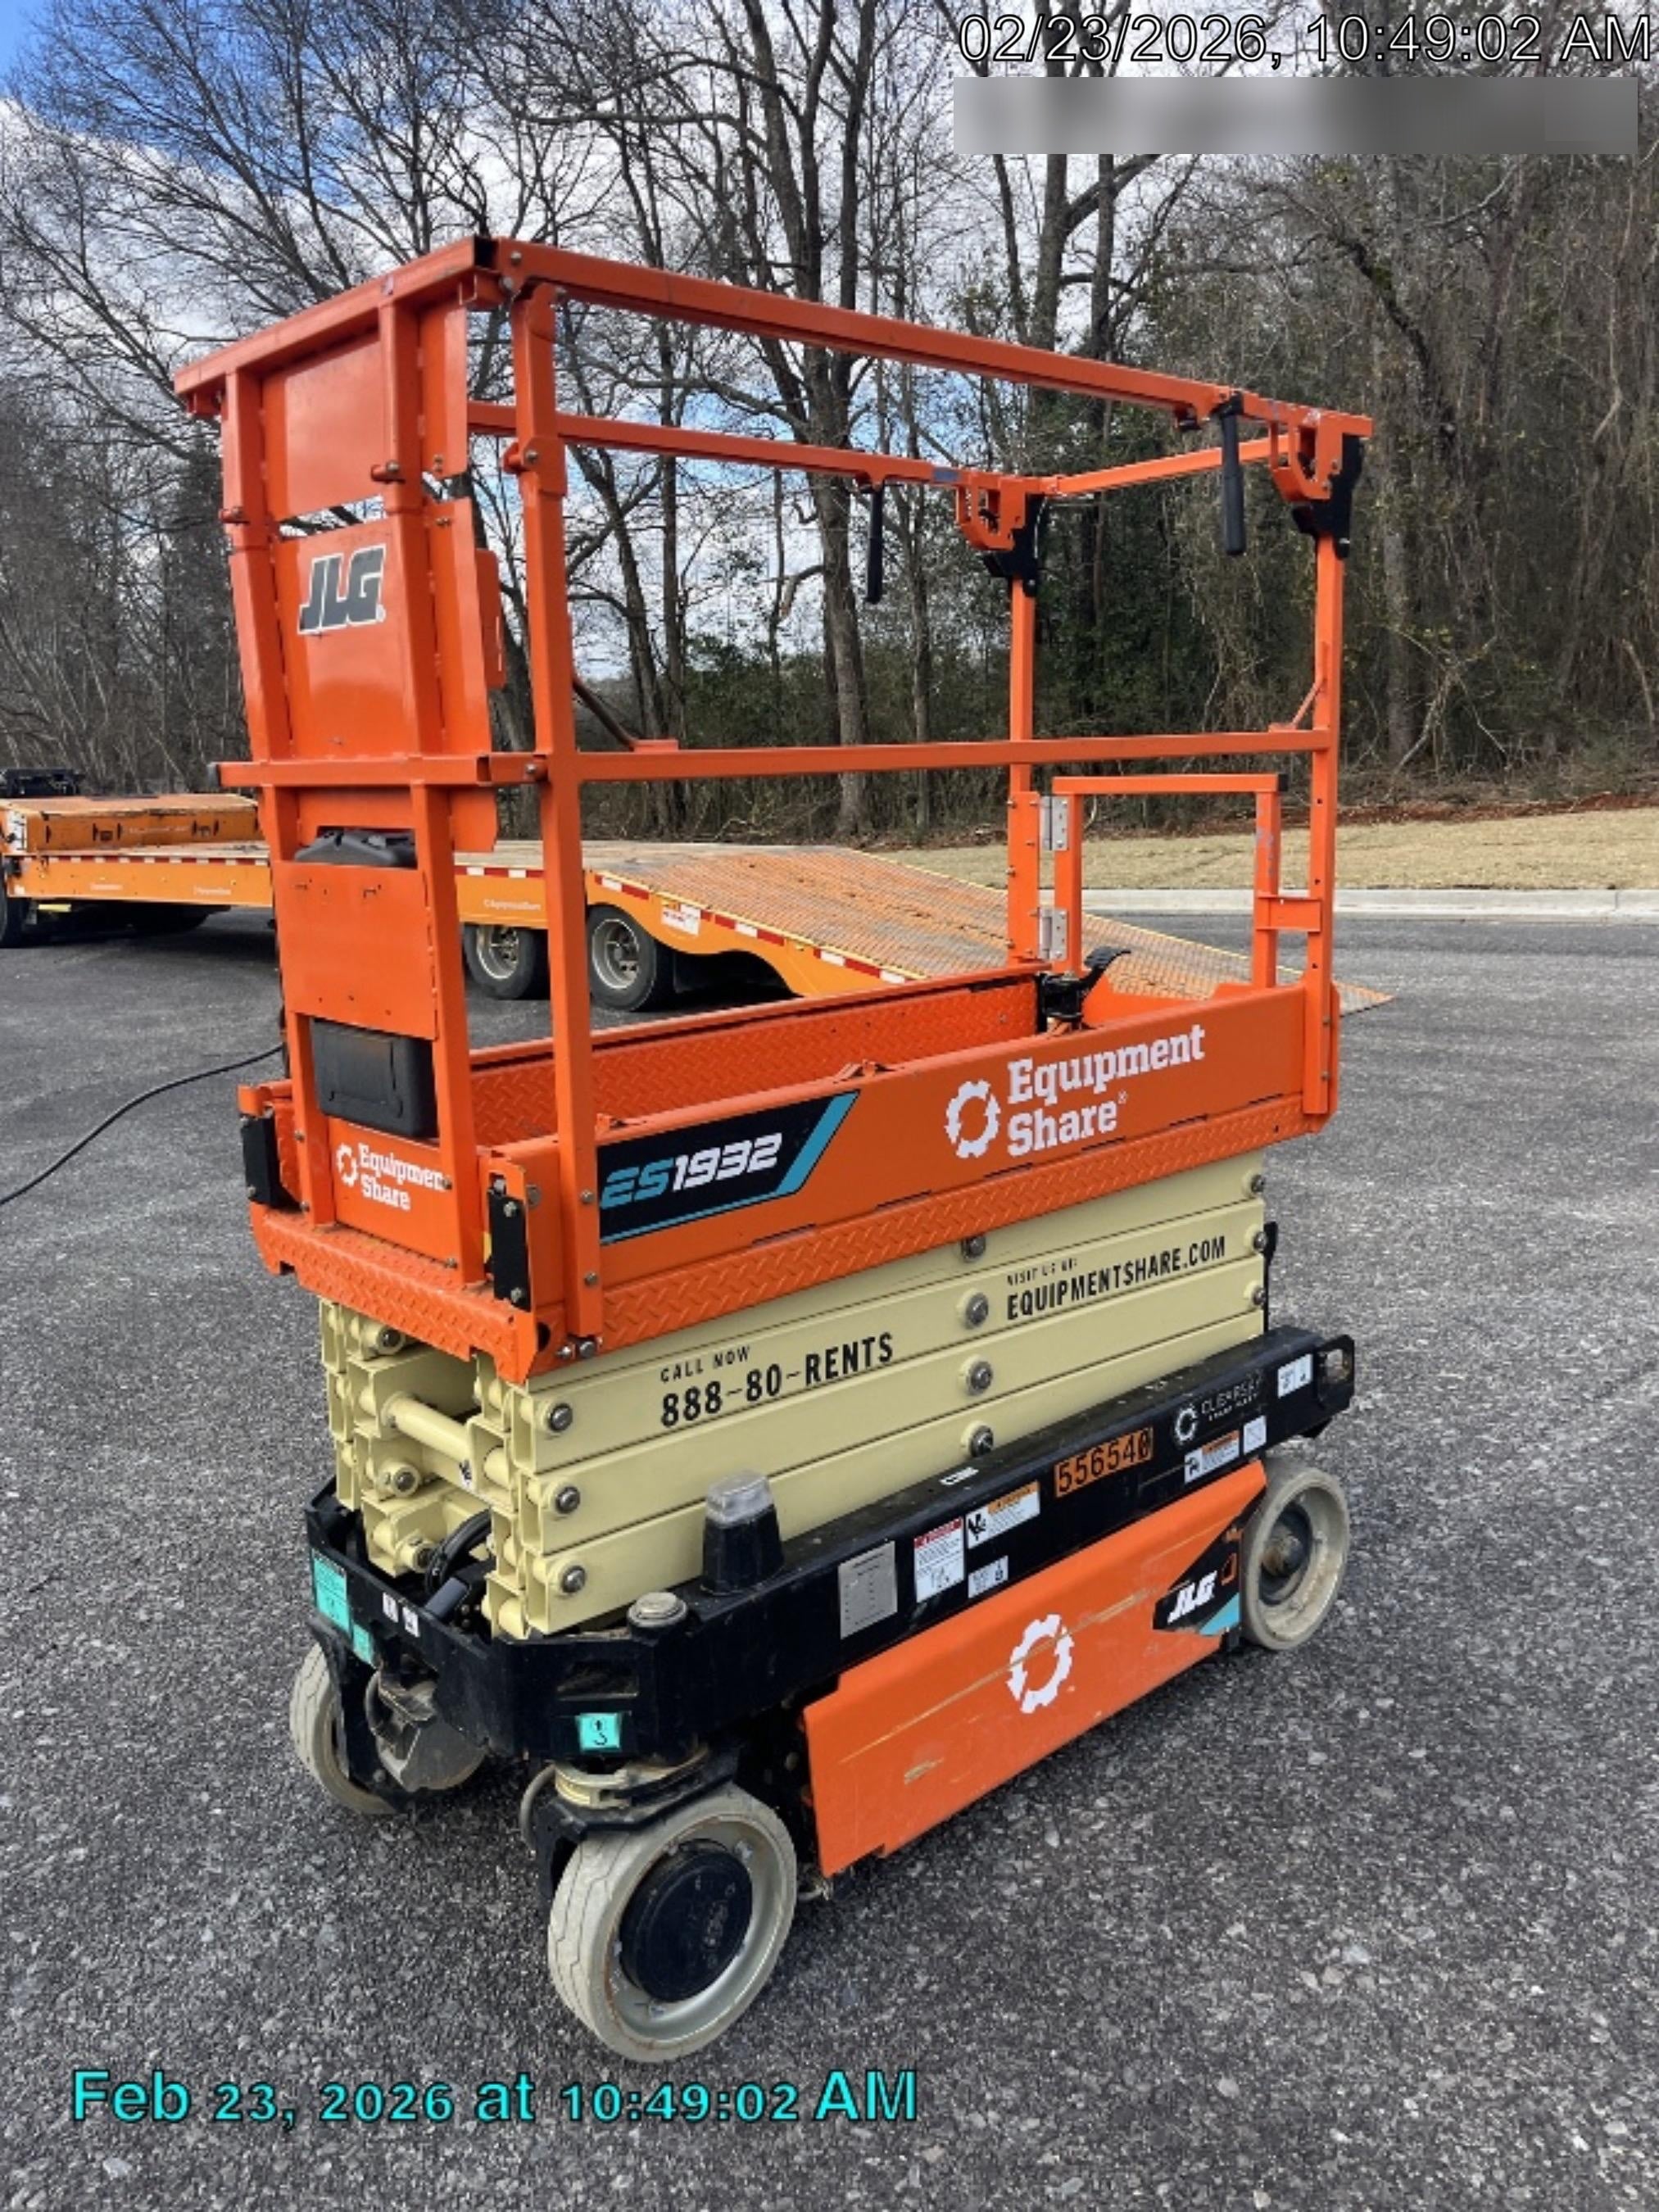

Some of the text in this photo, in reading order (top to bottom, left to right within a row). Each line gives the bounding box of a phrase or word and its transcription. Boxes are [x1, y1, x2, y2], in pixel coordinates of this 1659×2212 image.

[297, 543, 387, 635] JLG
[1007, 1023, 1206, 1106] Equipment
[360, 1173, 411, 1211] Share
[600, 1132, 783, 1210] ES1932
[1007, 1235, 1226, 1321] EQUIPMENTSHARE.COM
[660, 1346, 750, 1383] CALL NOW
[660, 1331, 895, 1427] 888-80-RENTS
[1167, 1570, 1217, 1624] JLG
